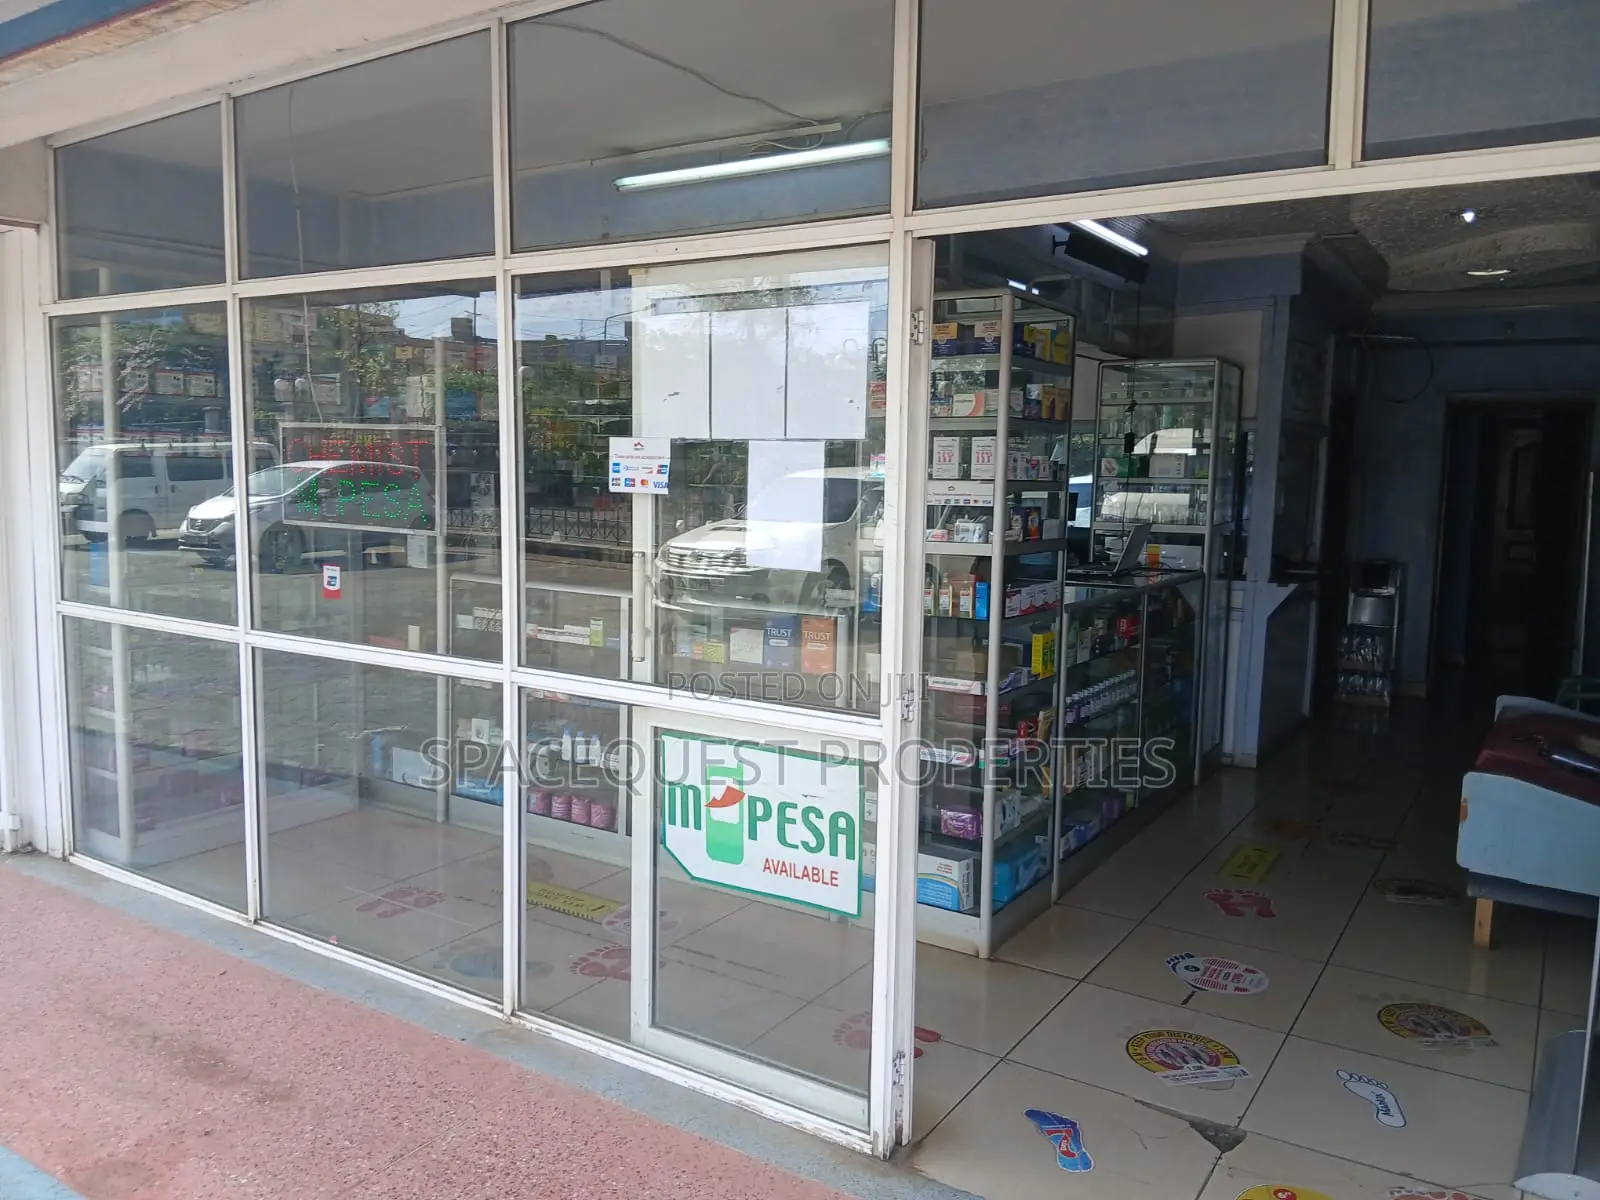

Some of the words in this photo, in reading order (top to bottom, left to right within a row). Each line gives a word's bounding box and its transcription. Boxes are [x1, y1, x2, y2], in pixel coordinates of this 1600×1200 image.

[287, 437, 429, 481] CHEMIST
[337, 480, 428, 523] PESA
[766, 627, 792, 638] TRUST
[803, 630, 832, 641] TRUST
[747, 794, 856, 861] PESA
[762, 858, 839, 887] AVAILABLE
